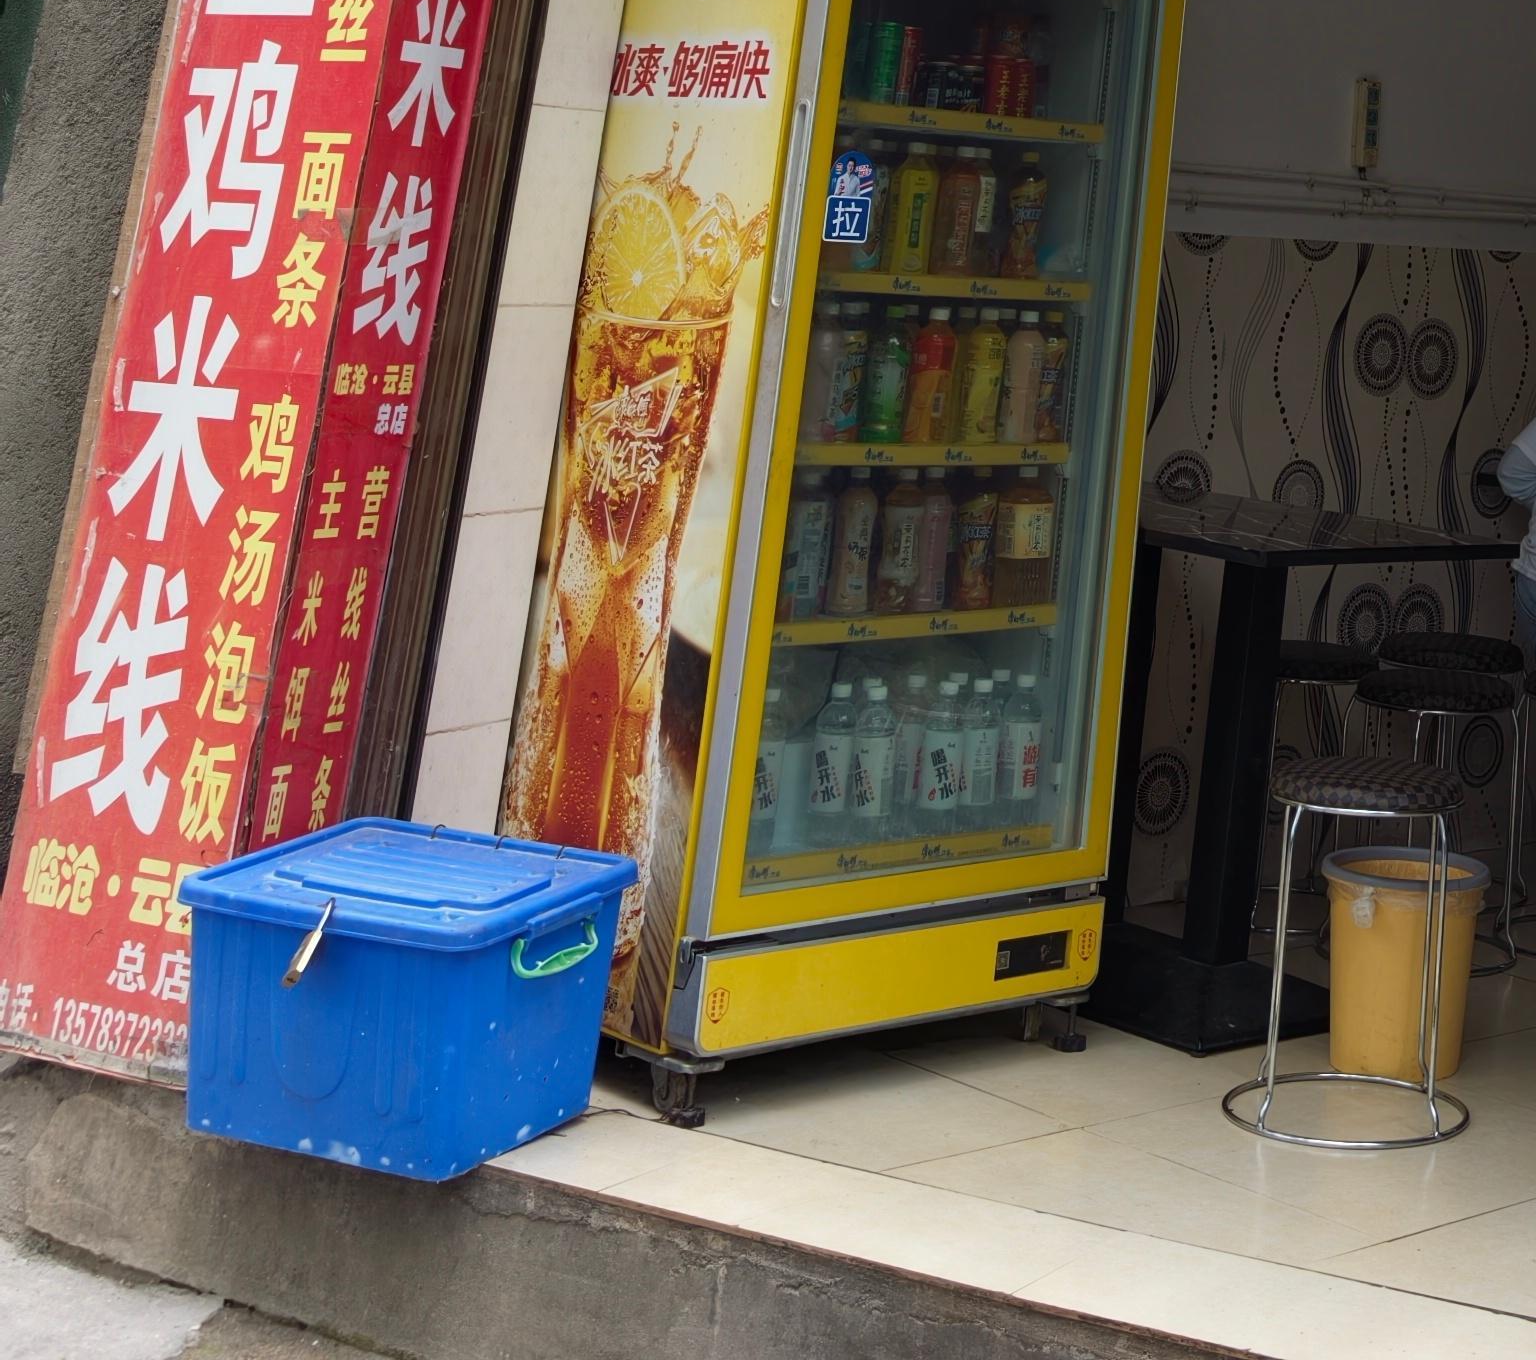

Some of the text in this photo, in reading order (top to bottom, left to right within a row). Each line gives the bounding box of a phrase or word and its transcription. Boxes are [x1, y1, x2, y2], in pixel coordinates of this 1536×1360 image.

[272, 131, 352, 328] 面条
[832, 201, 862, 237] 拉
[374, 403, 409, 436] 总店
[313, 467, 388, 540] 主营
[179, 393, 300, 846] 鸡汤泡饭
[291, 567, 368, 646] 米线
[281, 661, 350, 743] 饵丝
[261, 754, 334, 843] 面条
[106, 939, 191, 1004] 总店
